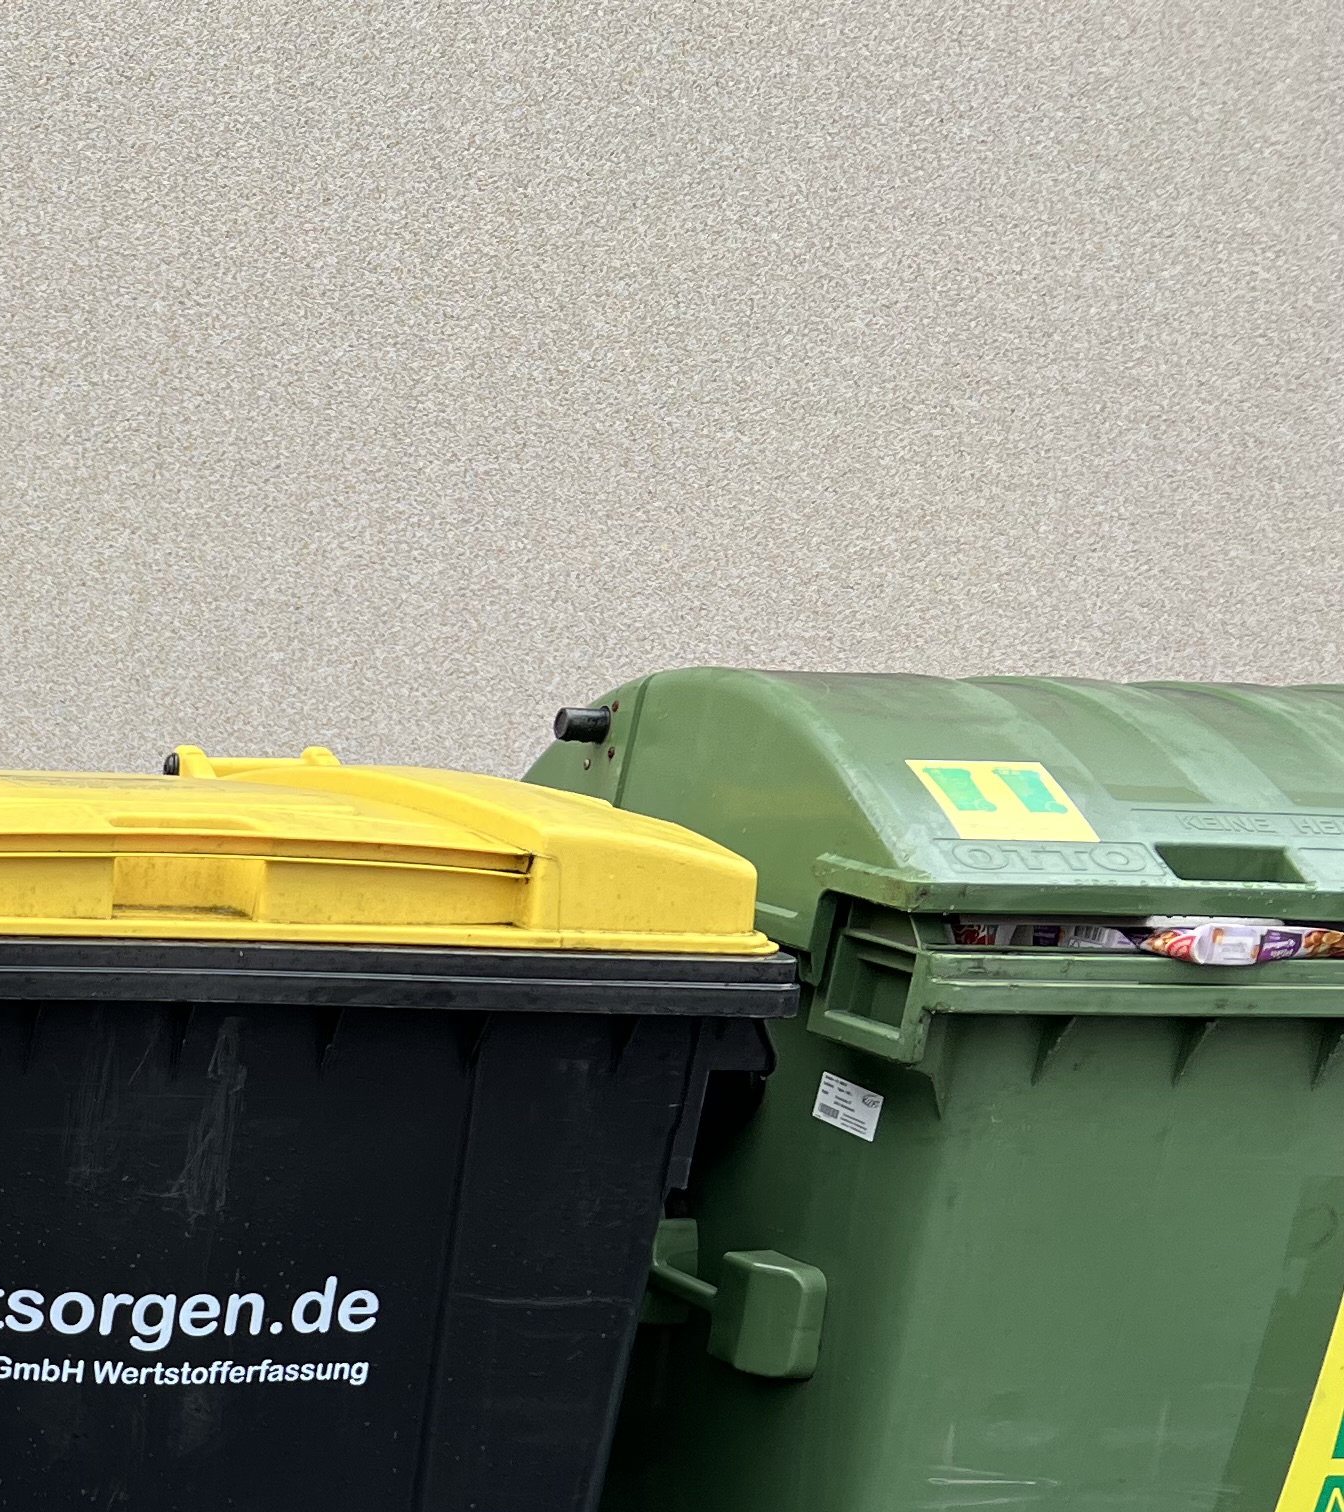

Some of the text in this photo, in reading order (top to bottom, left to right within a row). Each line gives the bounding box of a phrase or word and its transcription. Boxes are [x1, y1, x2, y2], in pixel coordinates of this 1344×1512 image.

[1176, 814, 1344, 836] KEINE HE
[951, 843, 1147, 873] OTTO
[93, 1358, 370, 1387] Wertstofferfassung
